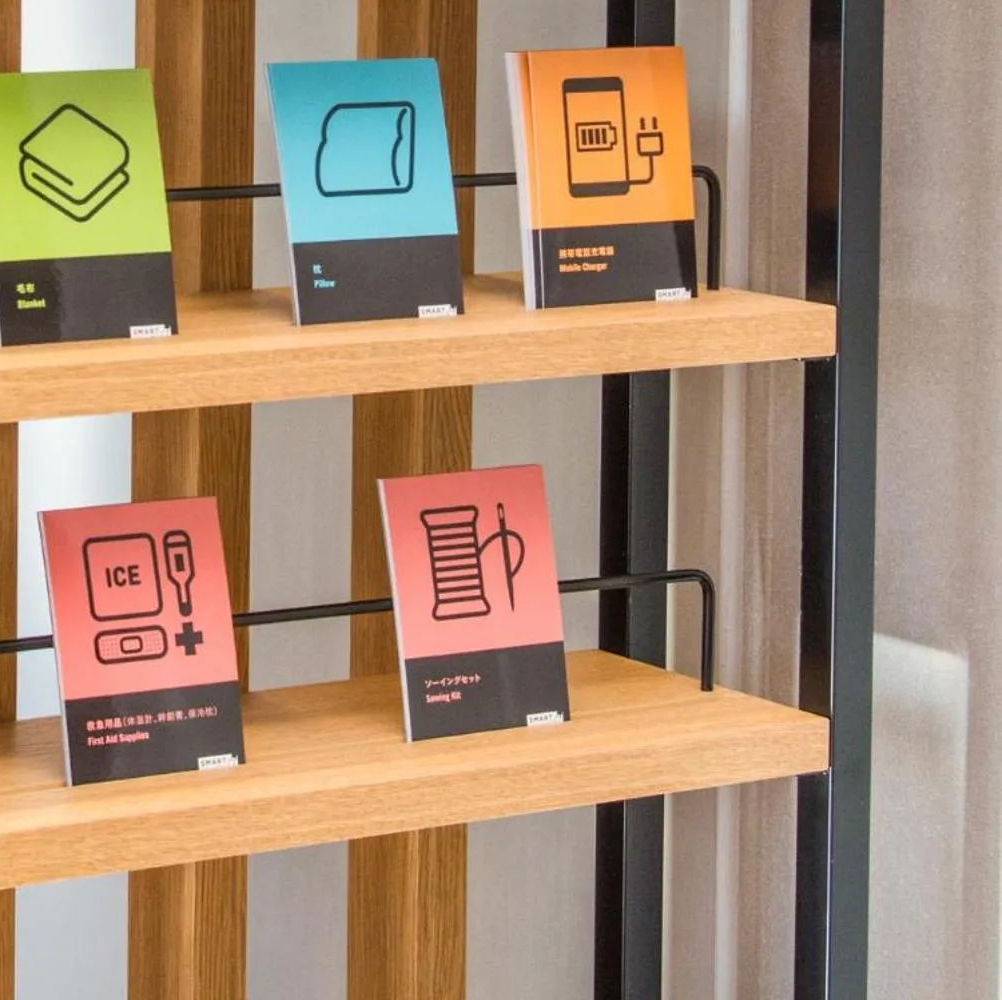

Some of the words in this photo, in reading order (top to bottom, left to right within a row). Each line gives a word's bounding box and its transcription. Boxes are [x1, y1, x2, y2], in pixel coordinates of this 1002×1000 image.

[559, 264, 582, 273] Mobile
[582, 262, 608, 272] Charger
[314, 279, 336, 288] Pillow
[105, 564, 141, 588] ICE
[425, 673, 481, 688] ソーイングセット
[426, 693, 450, 703] Sewing
[451, 691, 462, 700] Kit
[88, 736, 105, 747] First
[106, 734, 118, 744] Aid
[119, 731, 150, 743] Supplies
